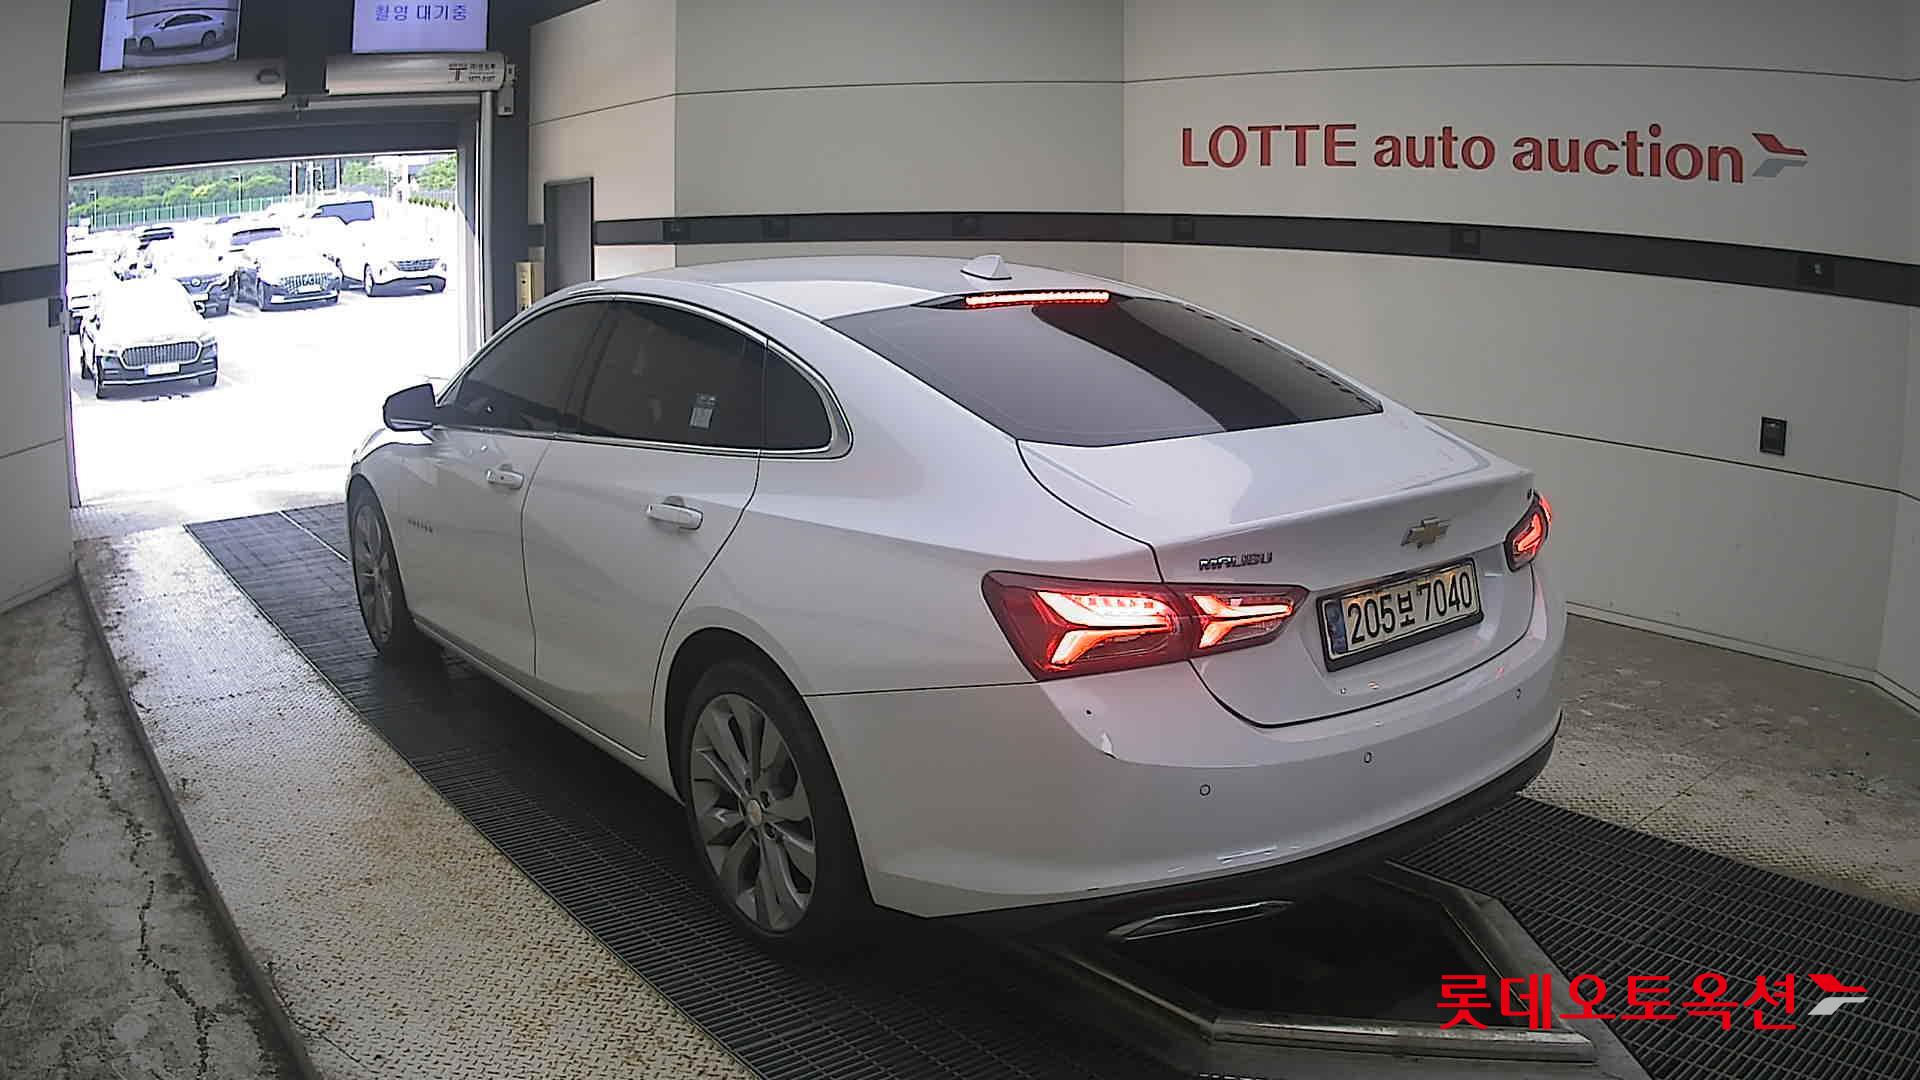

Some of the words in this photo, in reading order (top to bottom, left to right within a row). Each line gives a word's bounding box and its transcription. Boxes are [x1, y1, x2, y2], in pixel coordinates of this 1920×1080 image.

[1181, 124, 1358, 168] LOTTE
[1374, 126, 1496, 170] auto
[1512, 124, 1744, 183] auction
